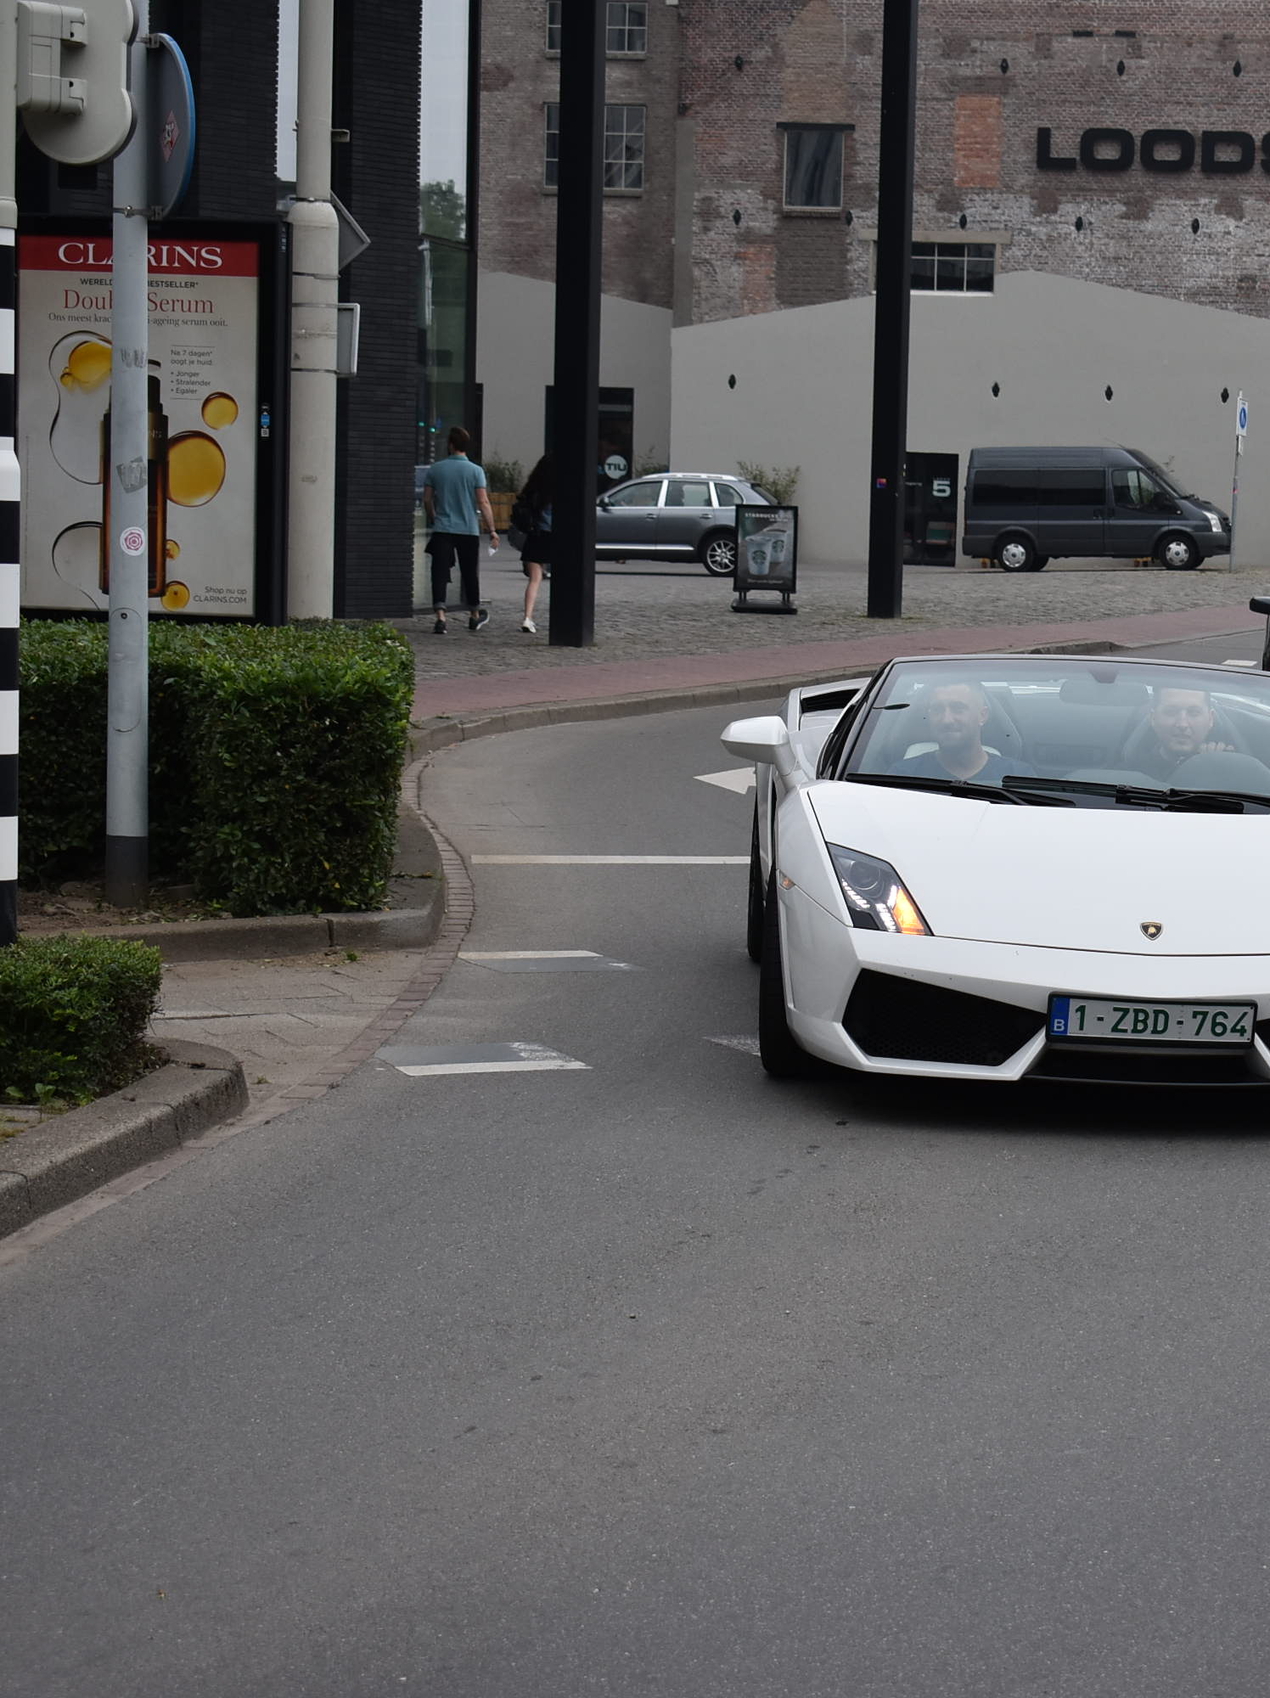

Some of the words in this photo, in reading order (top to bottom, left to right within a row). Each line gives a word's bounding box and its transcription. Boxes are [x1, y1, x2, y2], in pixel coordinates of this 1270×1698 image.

[58, 242, 223, 269] CLRINS
[64, 289, 113, 311] Dou
[147, 291, 214, 314] Serum
[49, 312, 66, 322] Ons
[68, 314, 92, 323] meest
[94, 313, 112, 323] krac
[182, 318, 208, 327] serum
[175, 379, 212, 387] Stralender
[175, 387, 198, 395] Egaler
[932, 480, 951, 497] 5
[204, 585, 225, 595] Shop
[193, 594, 248, 604] CLARINS.COM
[1053, 1018, 1066, 1031] B
[1074, 1004, 1249, 1038] 1-ZBD-764
